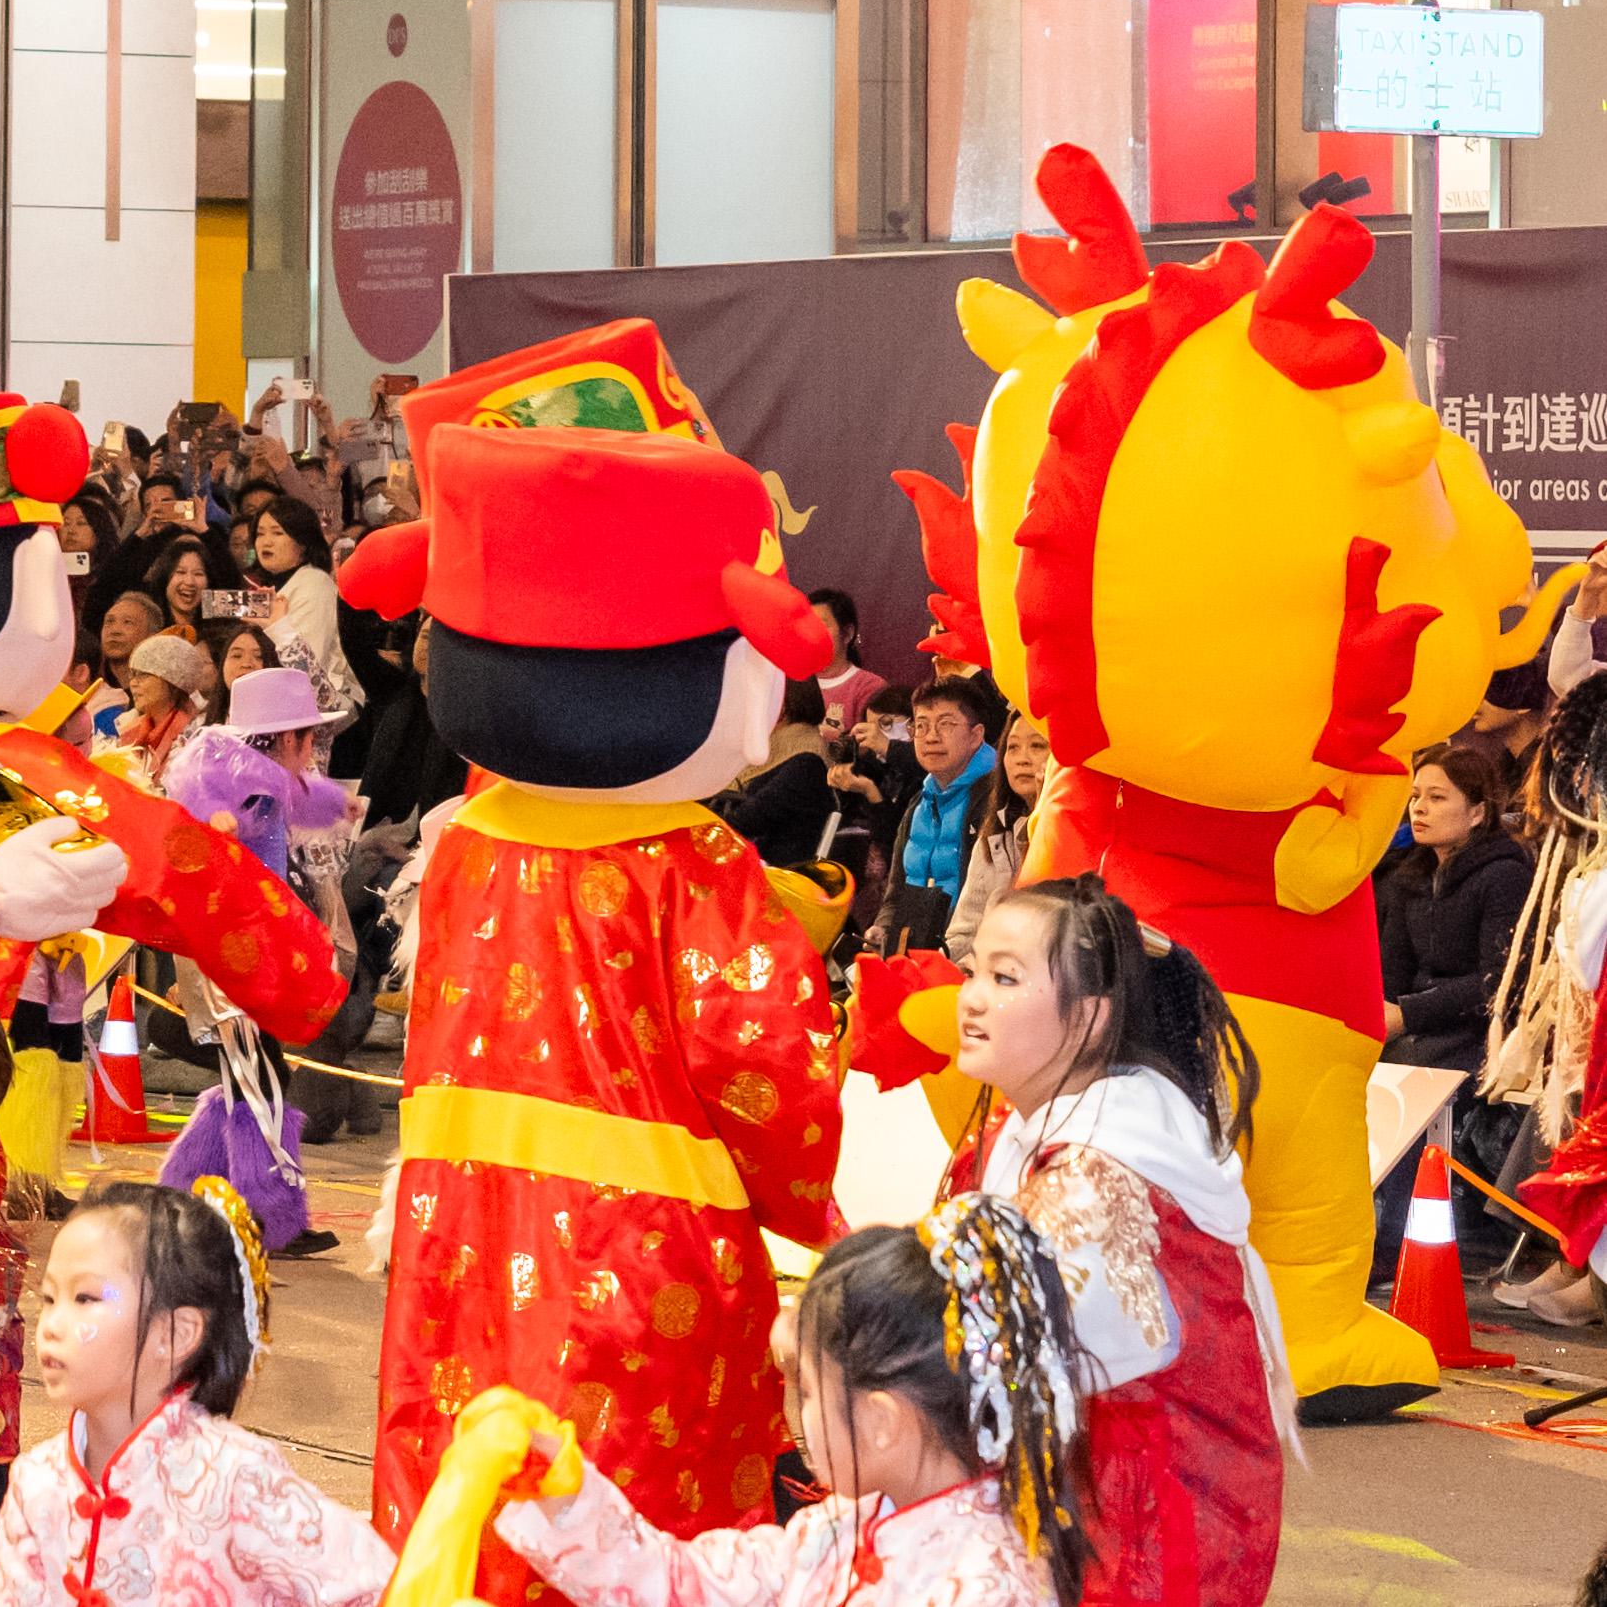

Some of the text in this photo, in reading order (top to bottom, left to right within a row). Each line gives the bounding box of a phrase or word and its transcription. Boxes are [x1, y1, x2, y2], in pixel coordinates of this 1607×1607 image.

[1355, 28, 1524, 58] TAXI STAND
[1376, 67, 1503, 112] 的士站
[1529, 479, 1590, 501] areas
